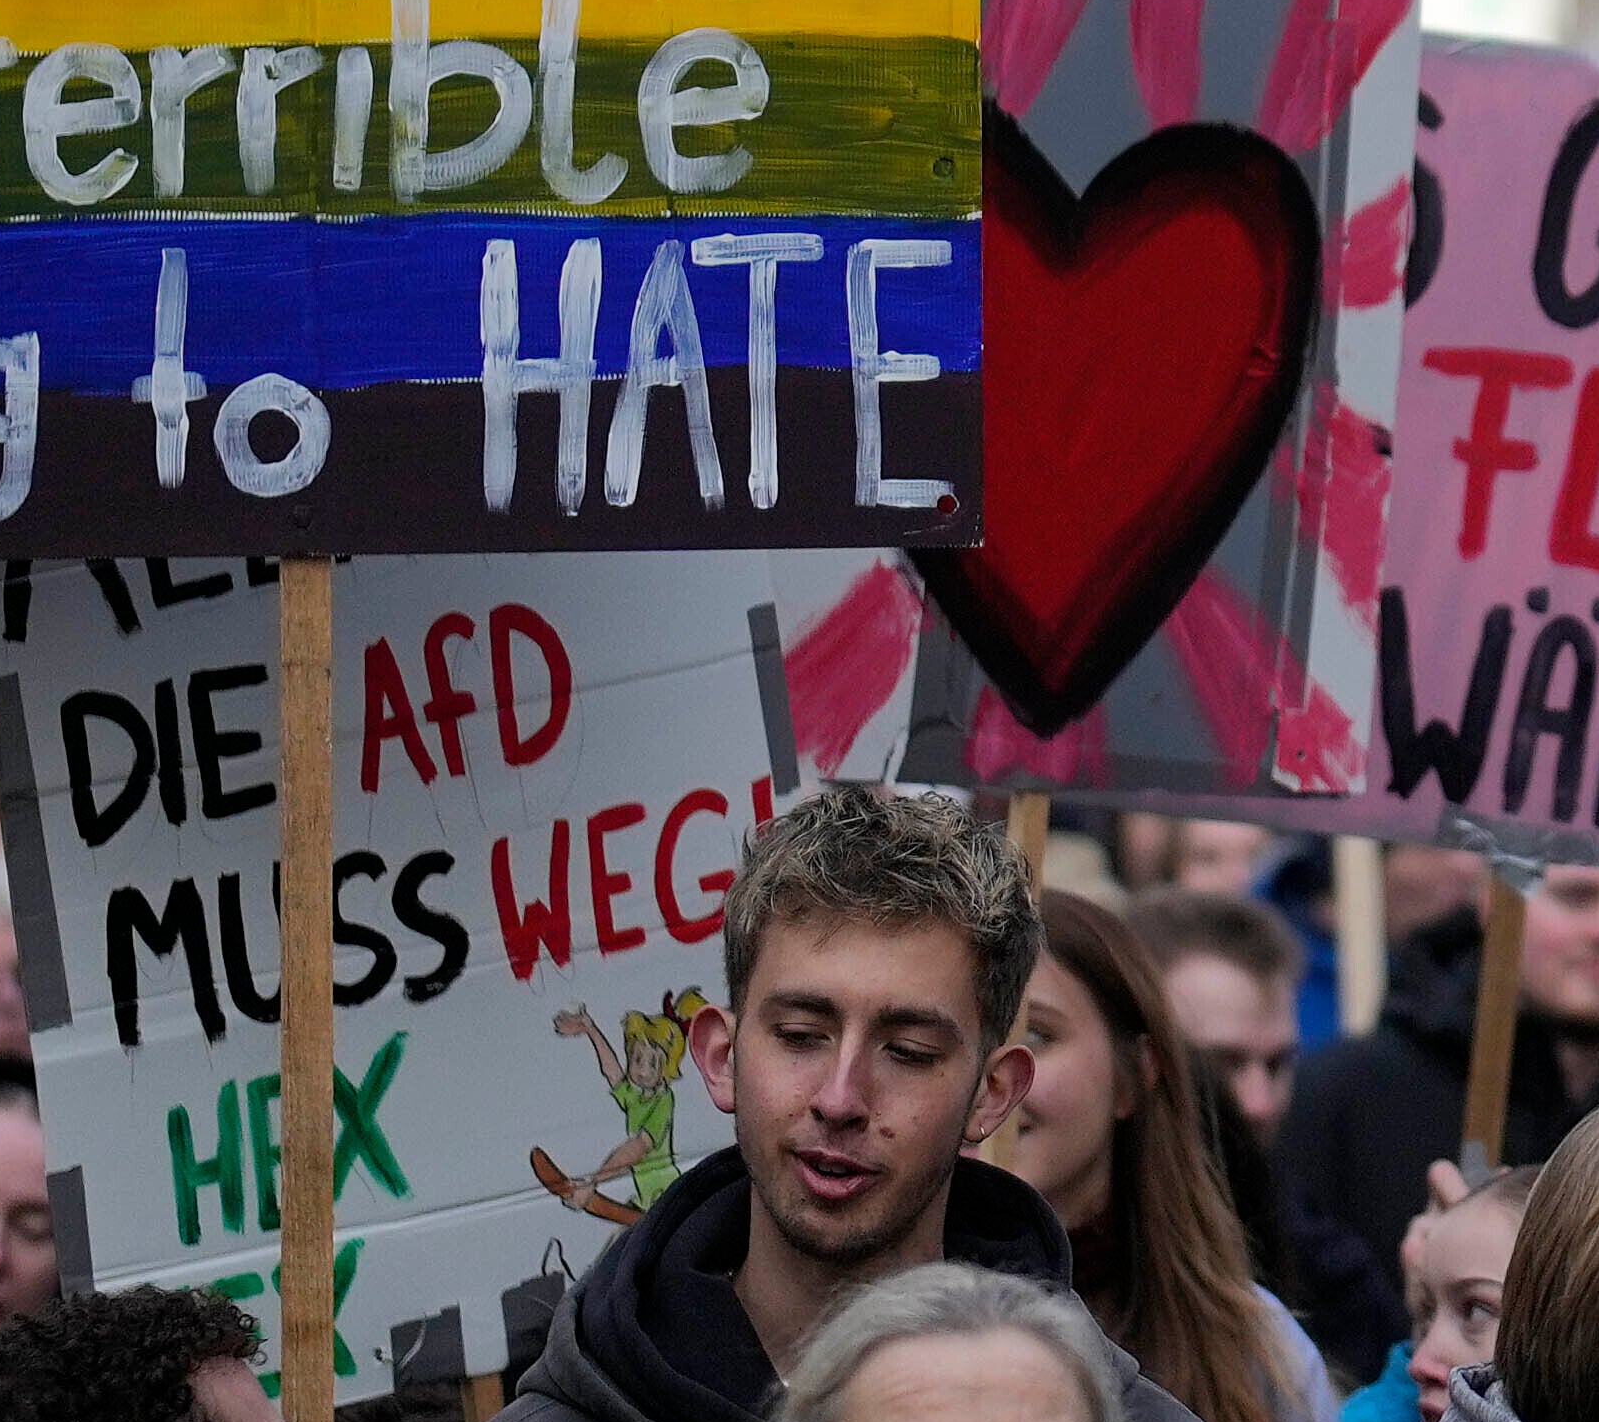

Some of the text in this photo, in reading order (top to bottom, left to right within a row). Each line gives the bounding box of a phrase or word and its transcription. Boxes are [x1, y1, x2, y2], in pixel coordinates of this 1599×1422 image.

[133, 247, 332, 498] to
[479, 234, 958, 518] HATE
[59, 602, 573, 848] DIE AfD
[105, 848, 471, 1047] MUSS
[166, 1030, 414, 1247] HEX
